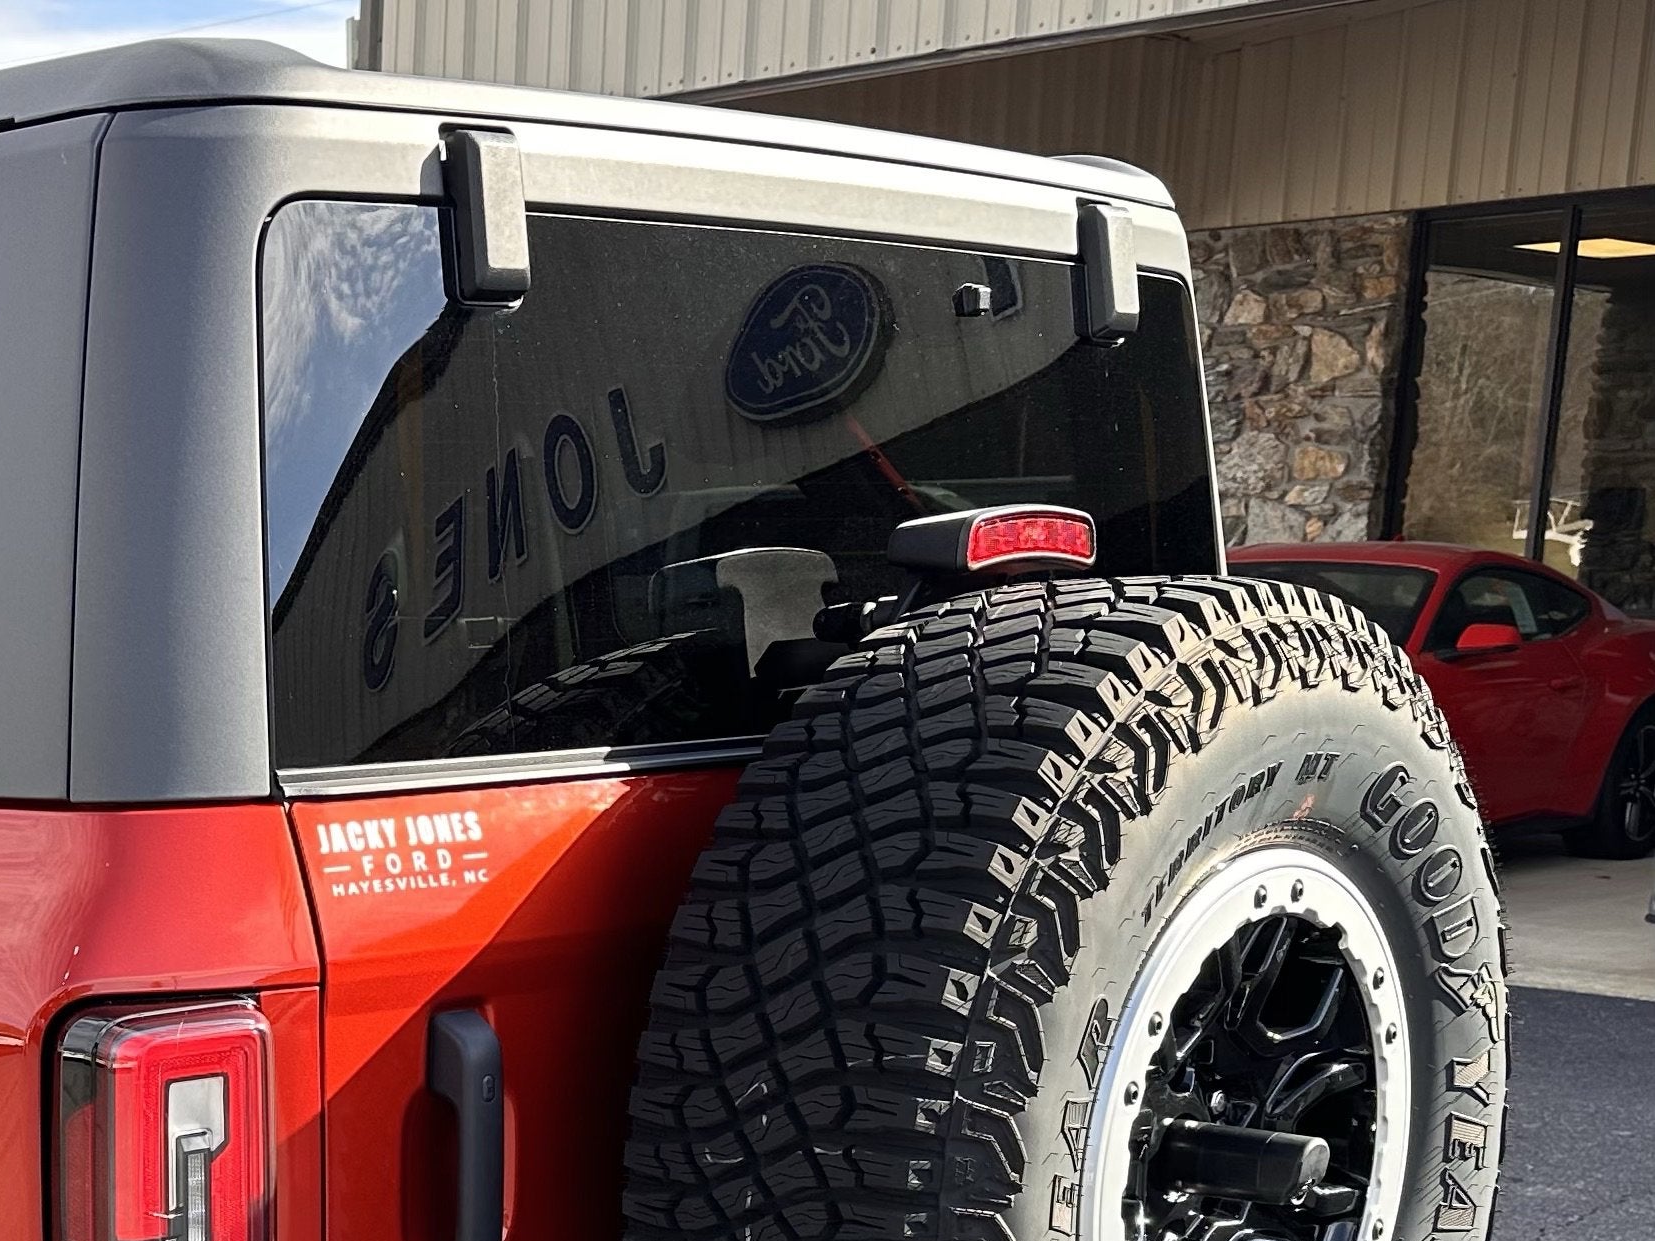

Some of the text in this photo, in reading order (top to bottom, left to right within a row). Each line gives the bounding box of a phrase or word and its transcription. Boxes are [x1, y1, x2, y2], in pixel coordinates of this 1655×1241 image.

[317, 810, 483, 854] JACKY JONES
[361, 848, 452, 877] FORD
[332, 868, 489, 897] HAYESVILLE, NC
